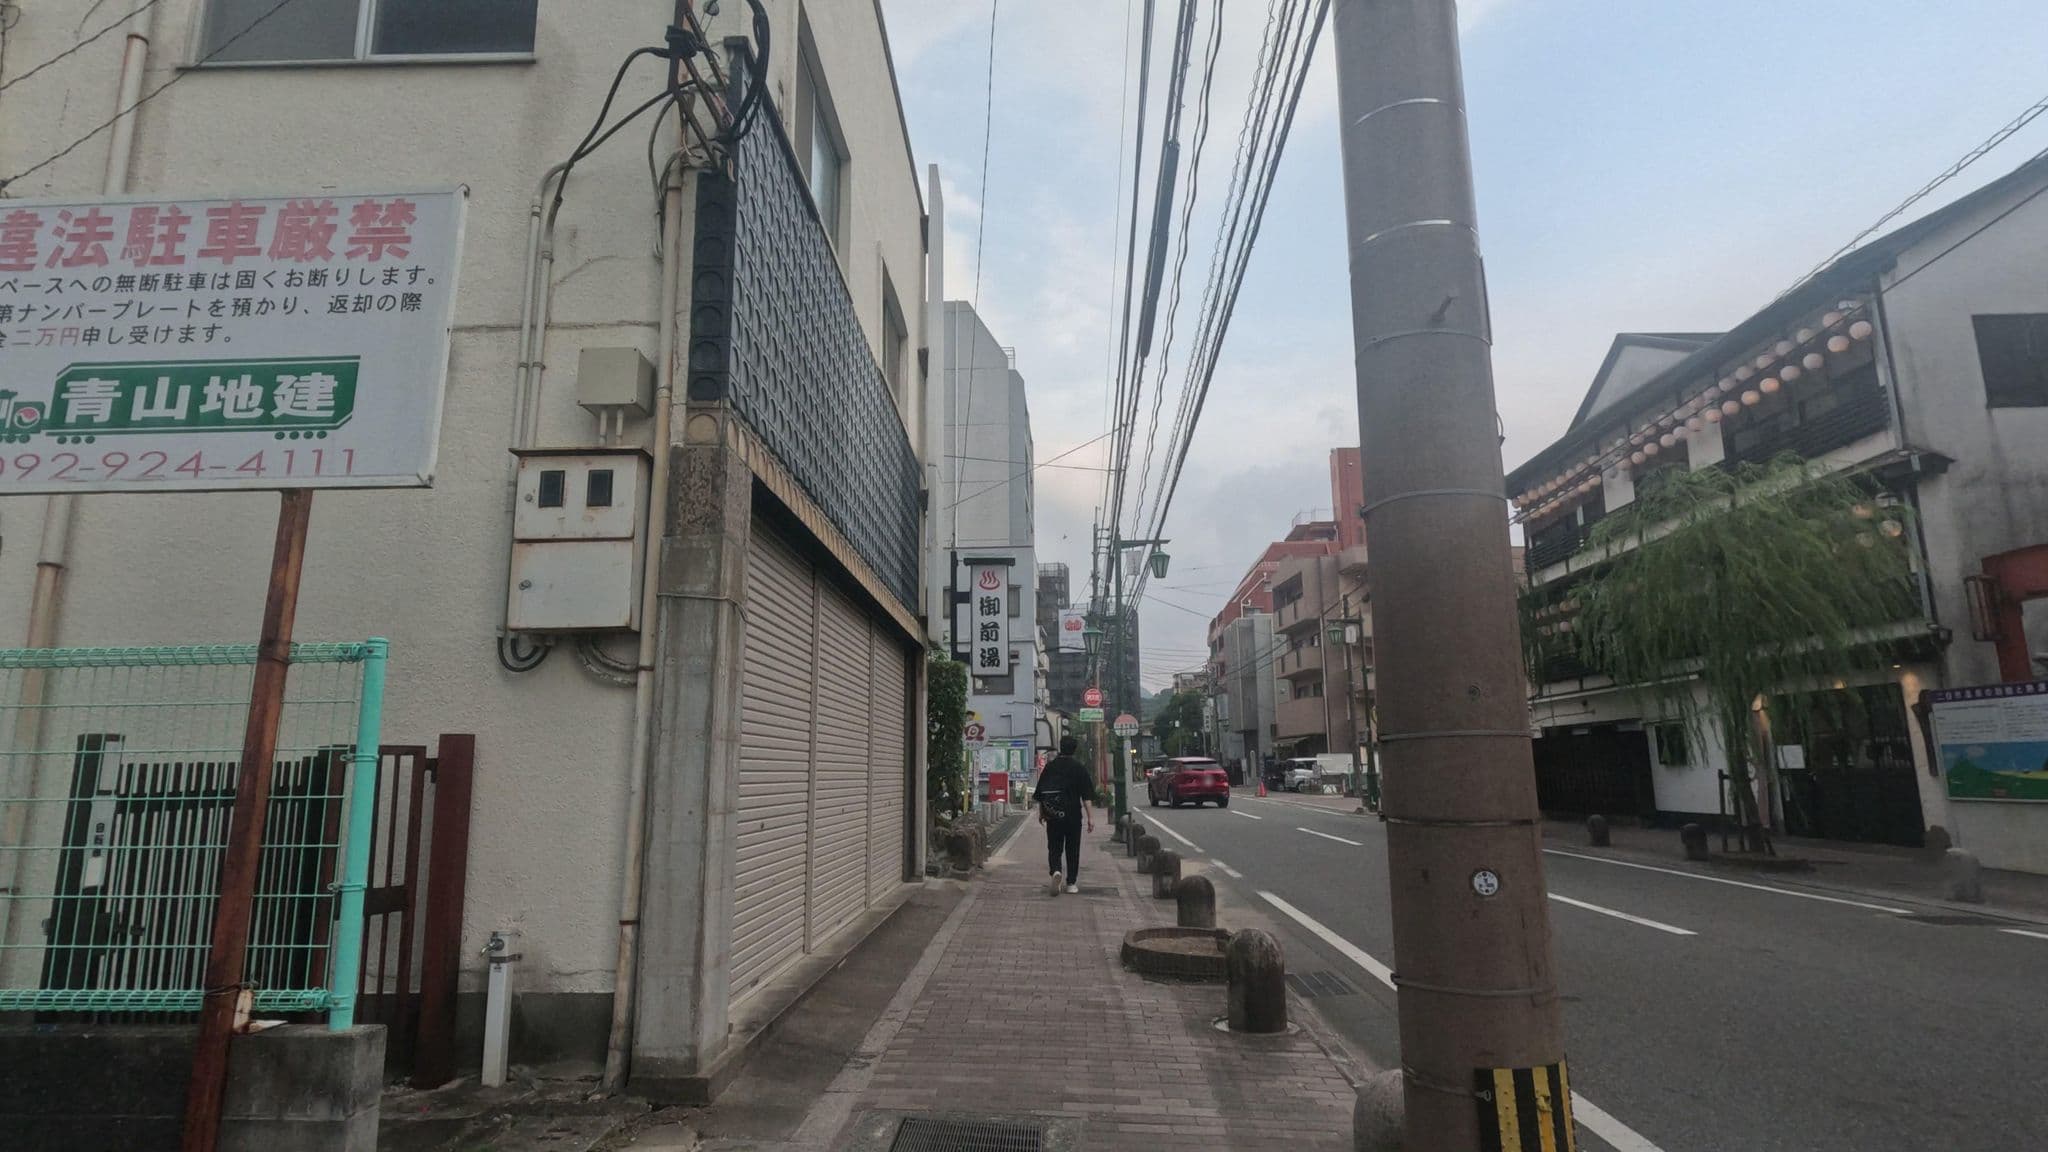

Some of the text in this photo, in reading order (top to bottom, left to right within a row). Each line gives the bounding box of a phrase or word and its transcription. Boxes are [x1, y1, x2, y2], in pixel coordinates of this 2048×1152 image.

[60, 371, 339, 425] 青山地建
[979, 596, 1001, 669] 御前湯
